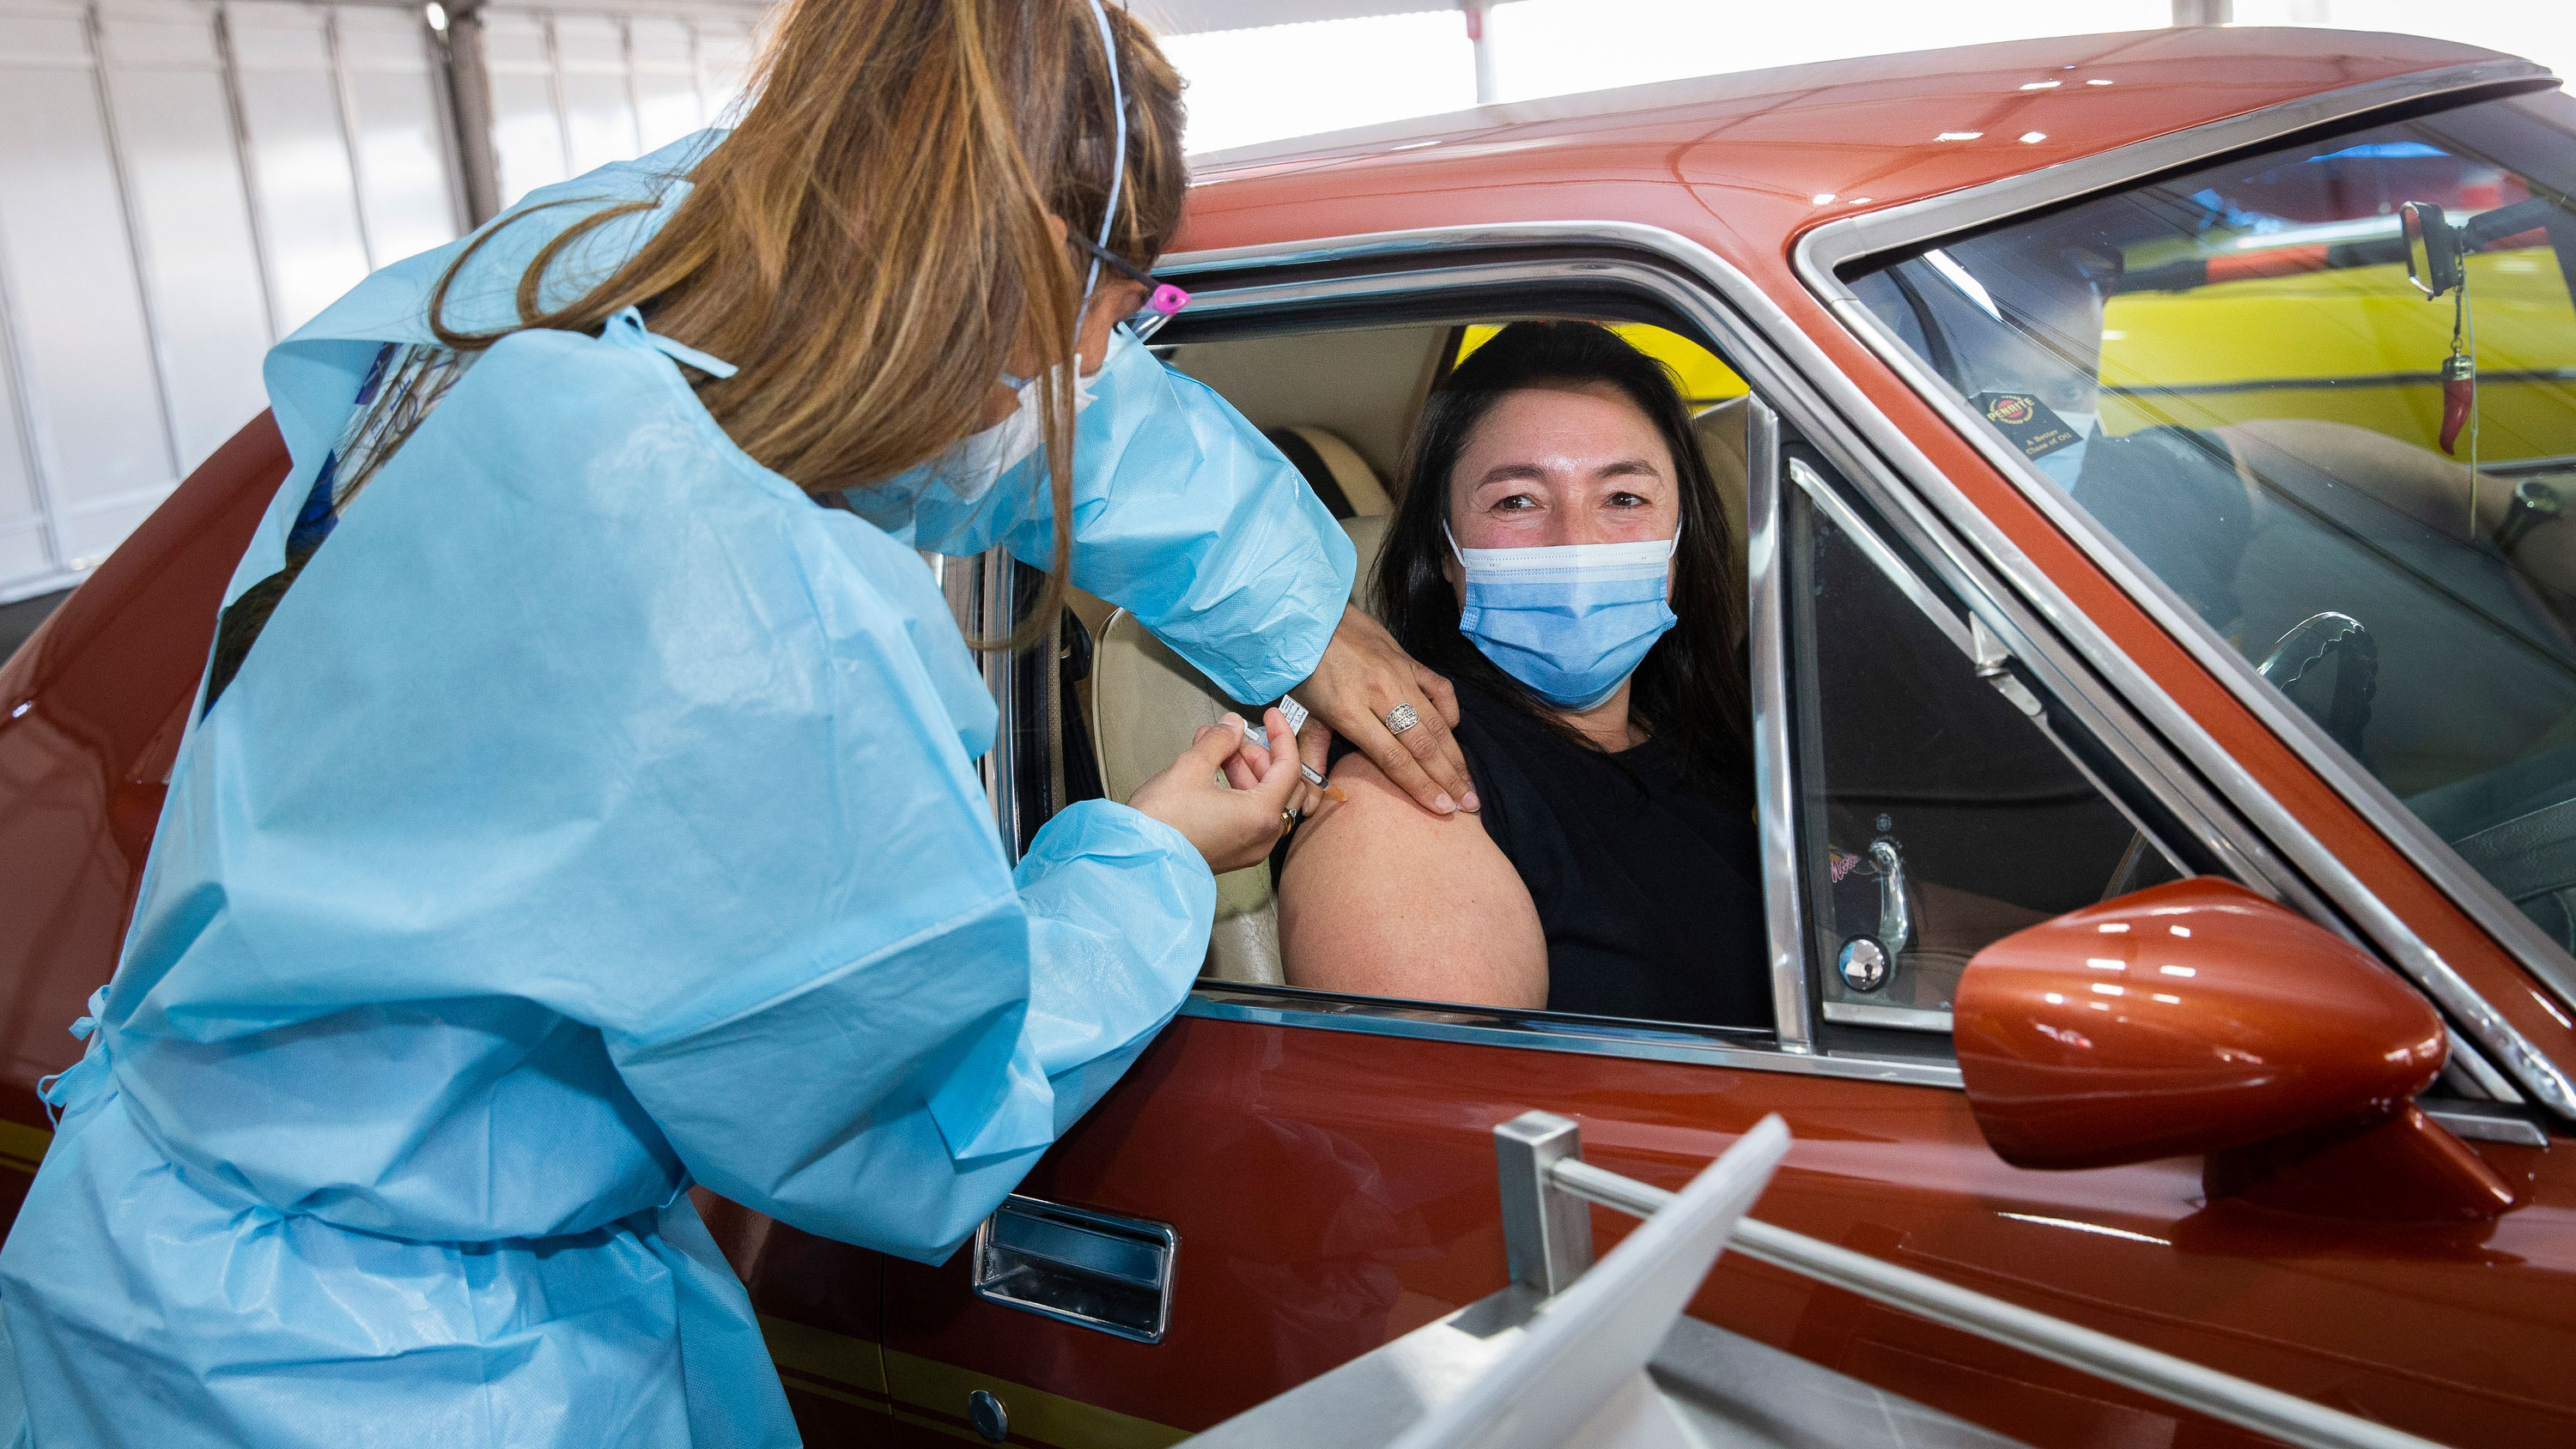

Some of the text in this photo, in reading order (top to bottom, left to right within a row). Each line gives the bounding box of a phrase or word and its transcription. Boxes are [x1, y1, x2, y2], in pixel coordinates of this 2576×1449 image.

[1986, 397, 2035, 422] PENRITE
[2026, 444, 2048, 455] Class
[2058, 432, 2072, 441] Oil
[2034, 429, 2058, 442] Better
